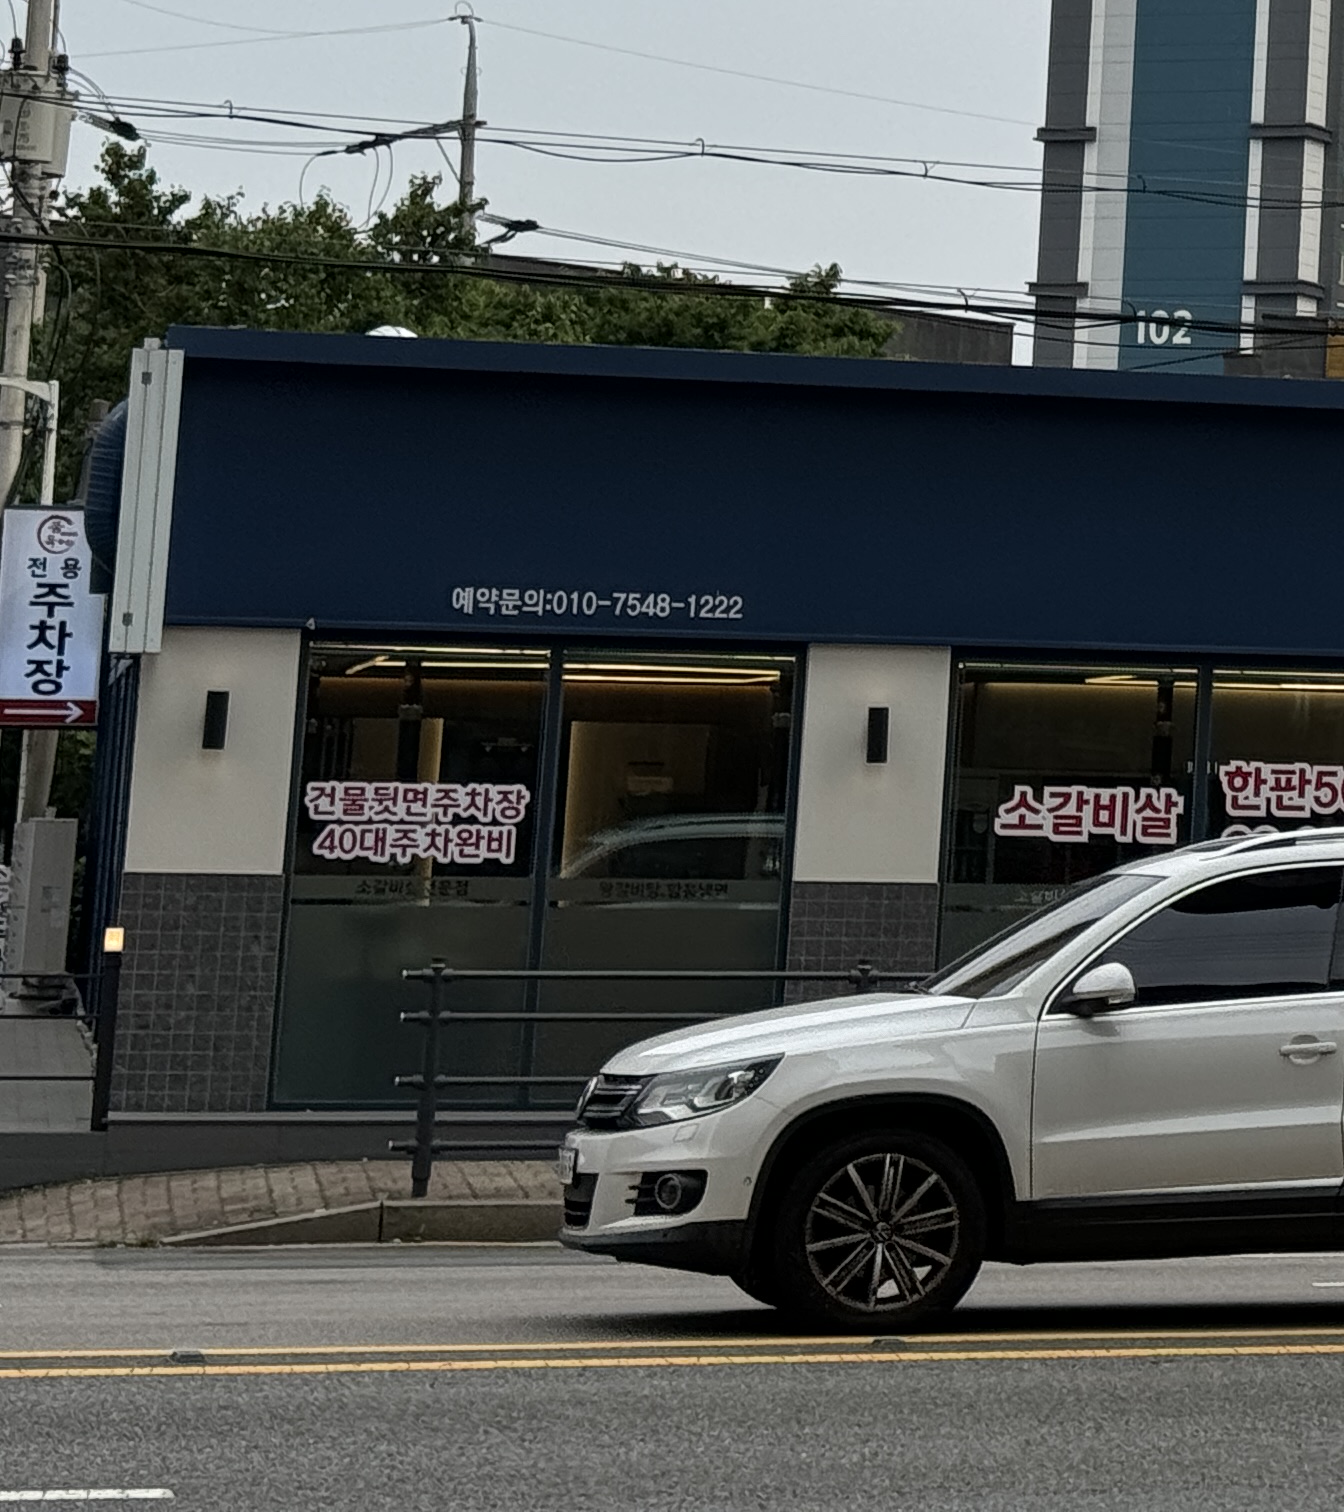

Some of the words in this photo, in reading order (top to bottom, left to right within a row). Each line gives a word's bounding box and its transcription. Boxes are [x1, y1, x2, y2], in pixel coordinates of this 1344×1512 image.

[1137, 310, 1192, 344] 102
[25, 582, 74, 696] 주차장
[307, 784, 527, 820] 건물뒷면주차장
[998, 787, 1181, 840] 소갈비살
[315, 826, 514, 861] 40대주차완비
